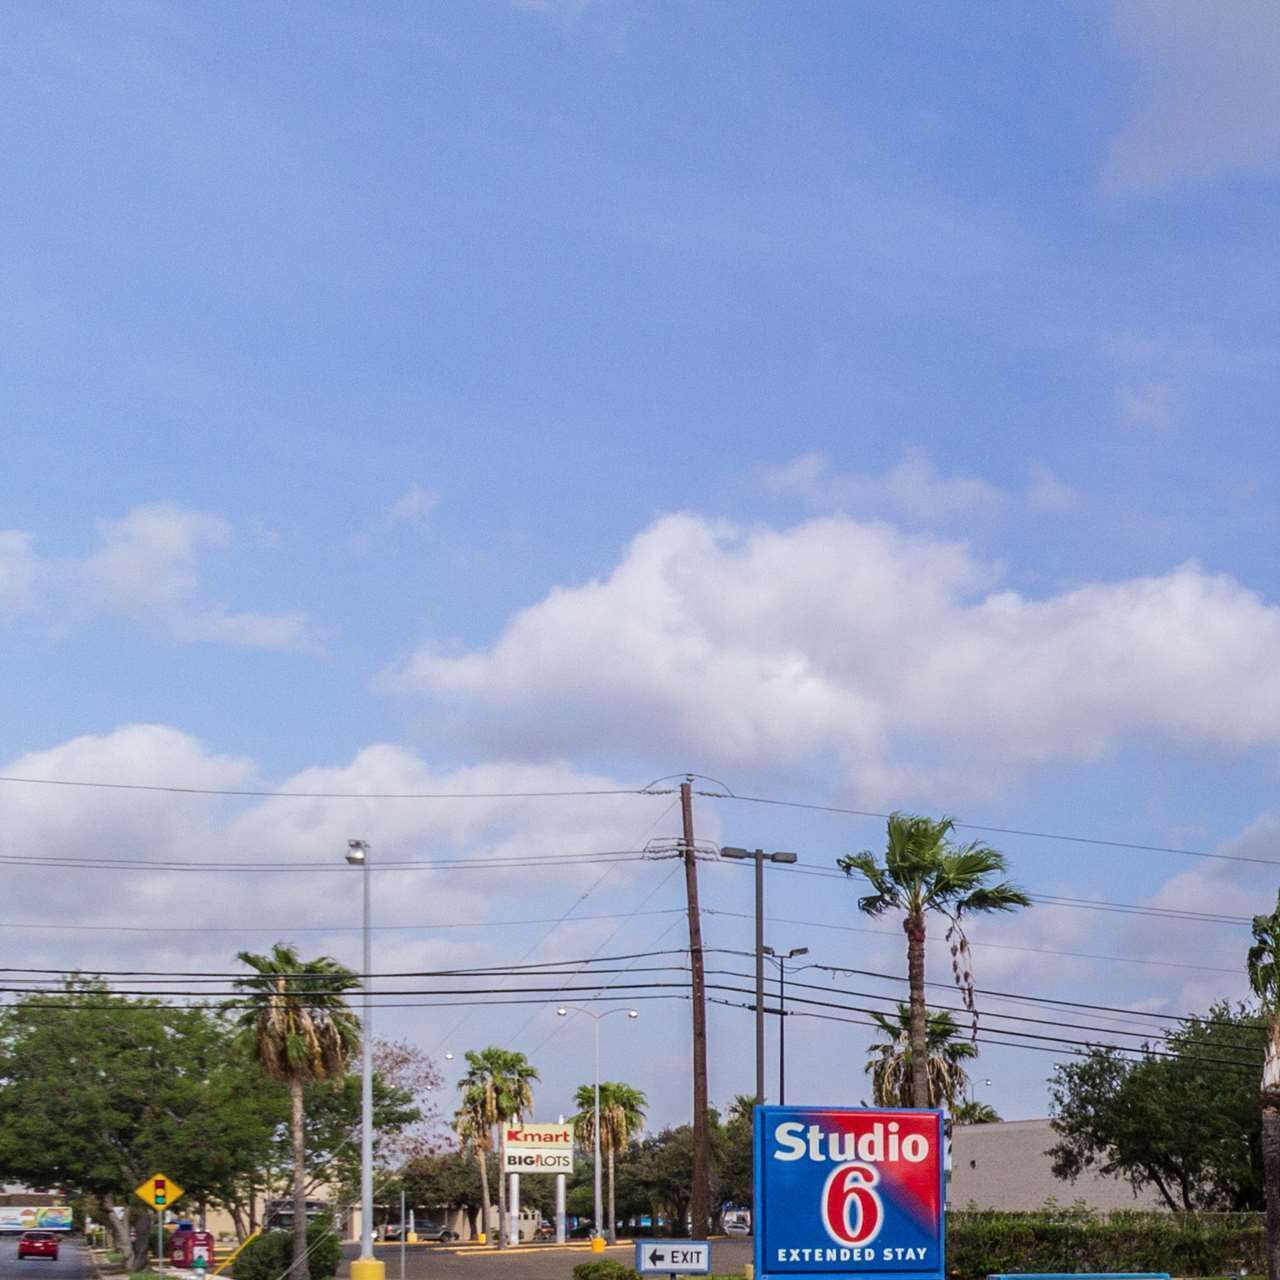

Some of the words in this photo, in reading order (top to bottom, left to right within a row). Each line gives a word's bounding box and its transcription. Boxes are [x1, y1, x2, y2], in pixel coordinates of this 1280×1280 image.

[507, 1130, 570, 1143] Kmart
[773, 1121, 930, 1163] Studio
[821, 1162, 884, 1248] 6
[671, 1250, 702, 1264] EXIT
[777, 1248, 876, 1262] EXTENDED
[882, 1247, 928, 1261] STAY
